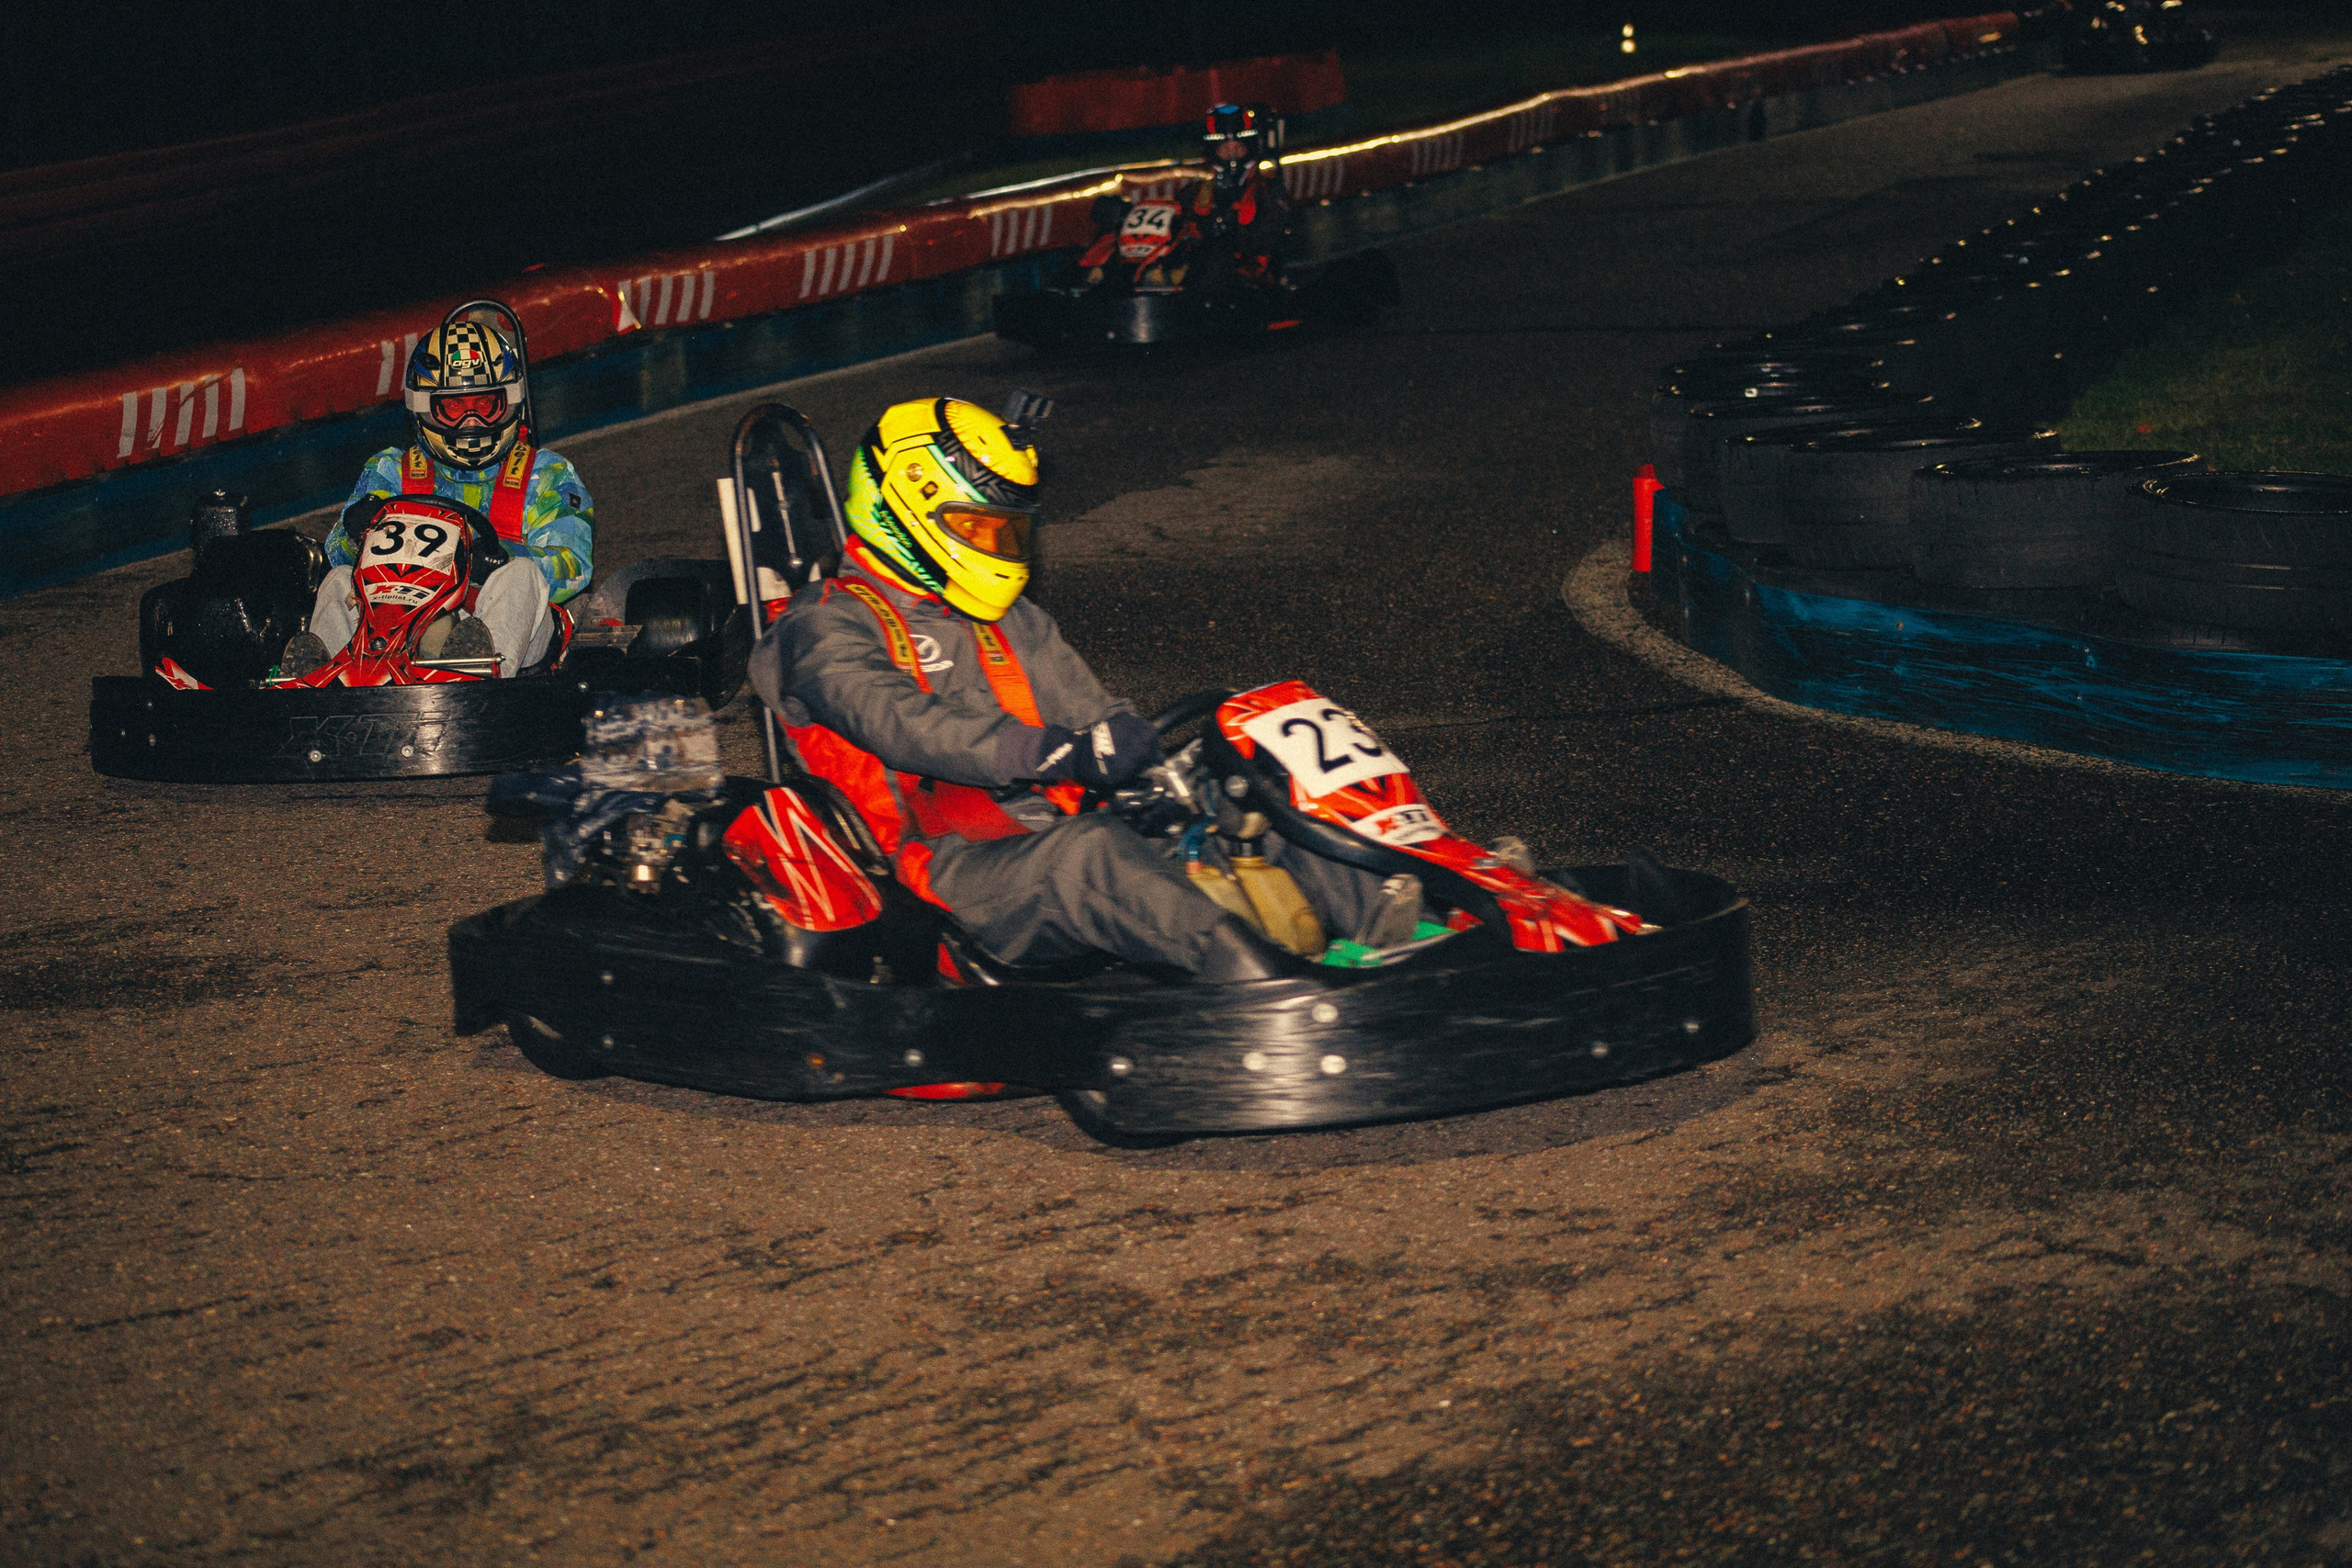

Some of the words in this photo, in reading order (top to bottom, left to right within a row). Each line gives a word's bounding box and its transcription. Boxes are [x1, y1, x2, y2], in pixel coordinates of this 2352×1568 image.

[1127, 209, 1165, 230] 34
[452, 357, 481, 368] agv
[370, 520, 448, 558] 39
[1281, 707, 1382, 773] 23
